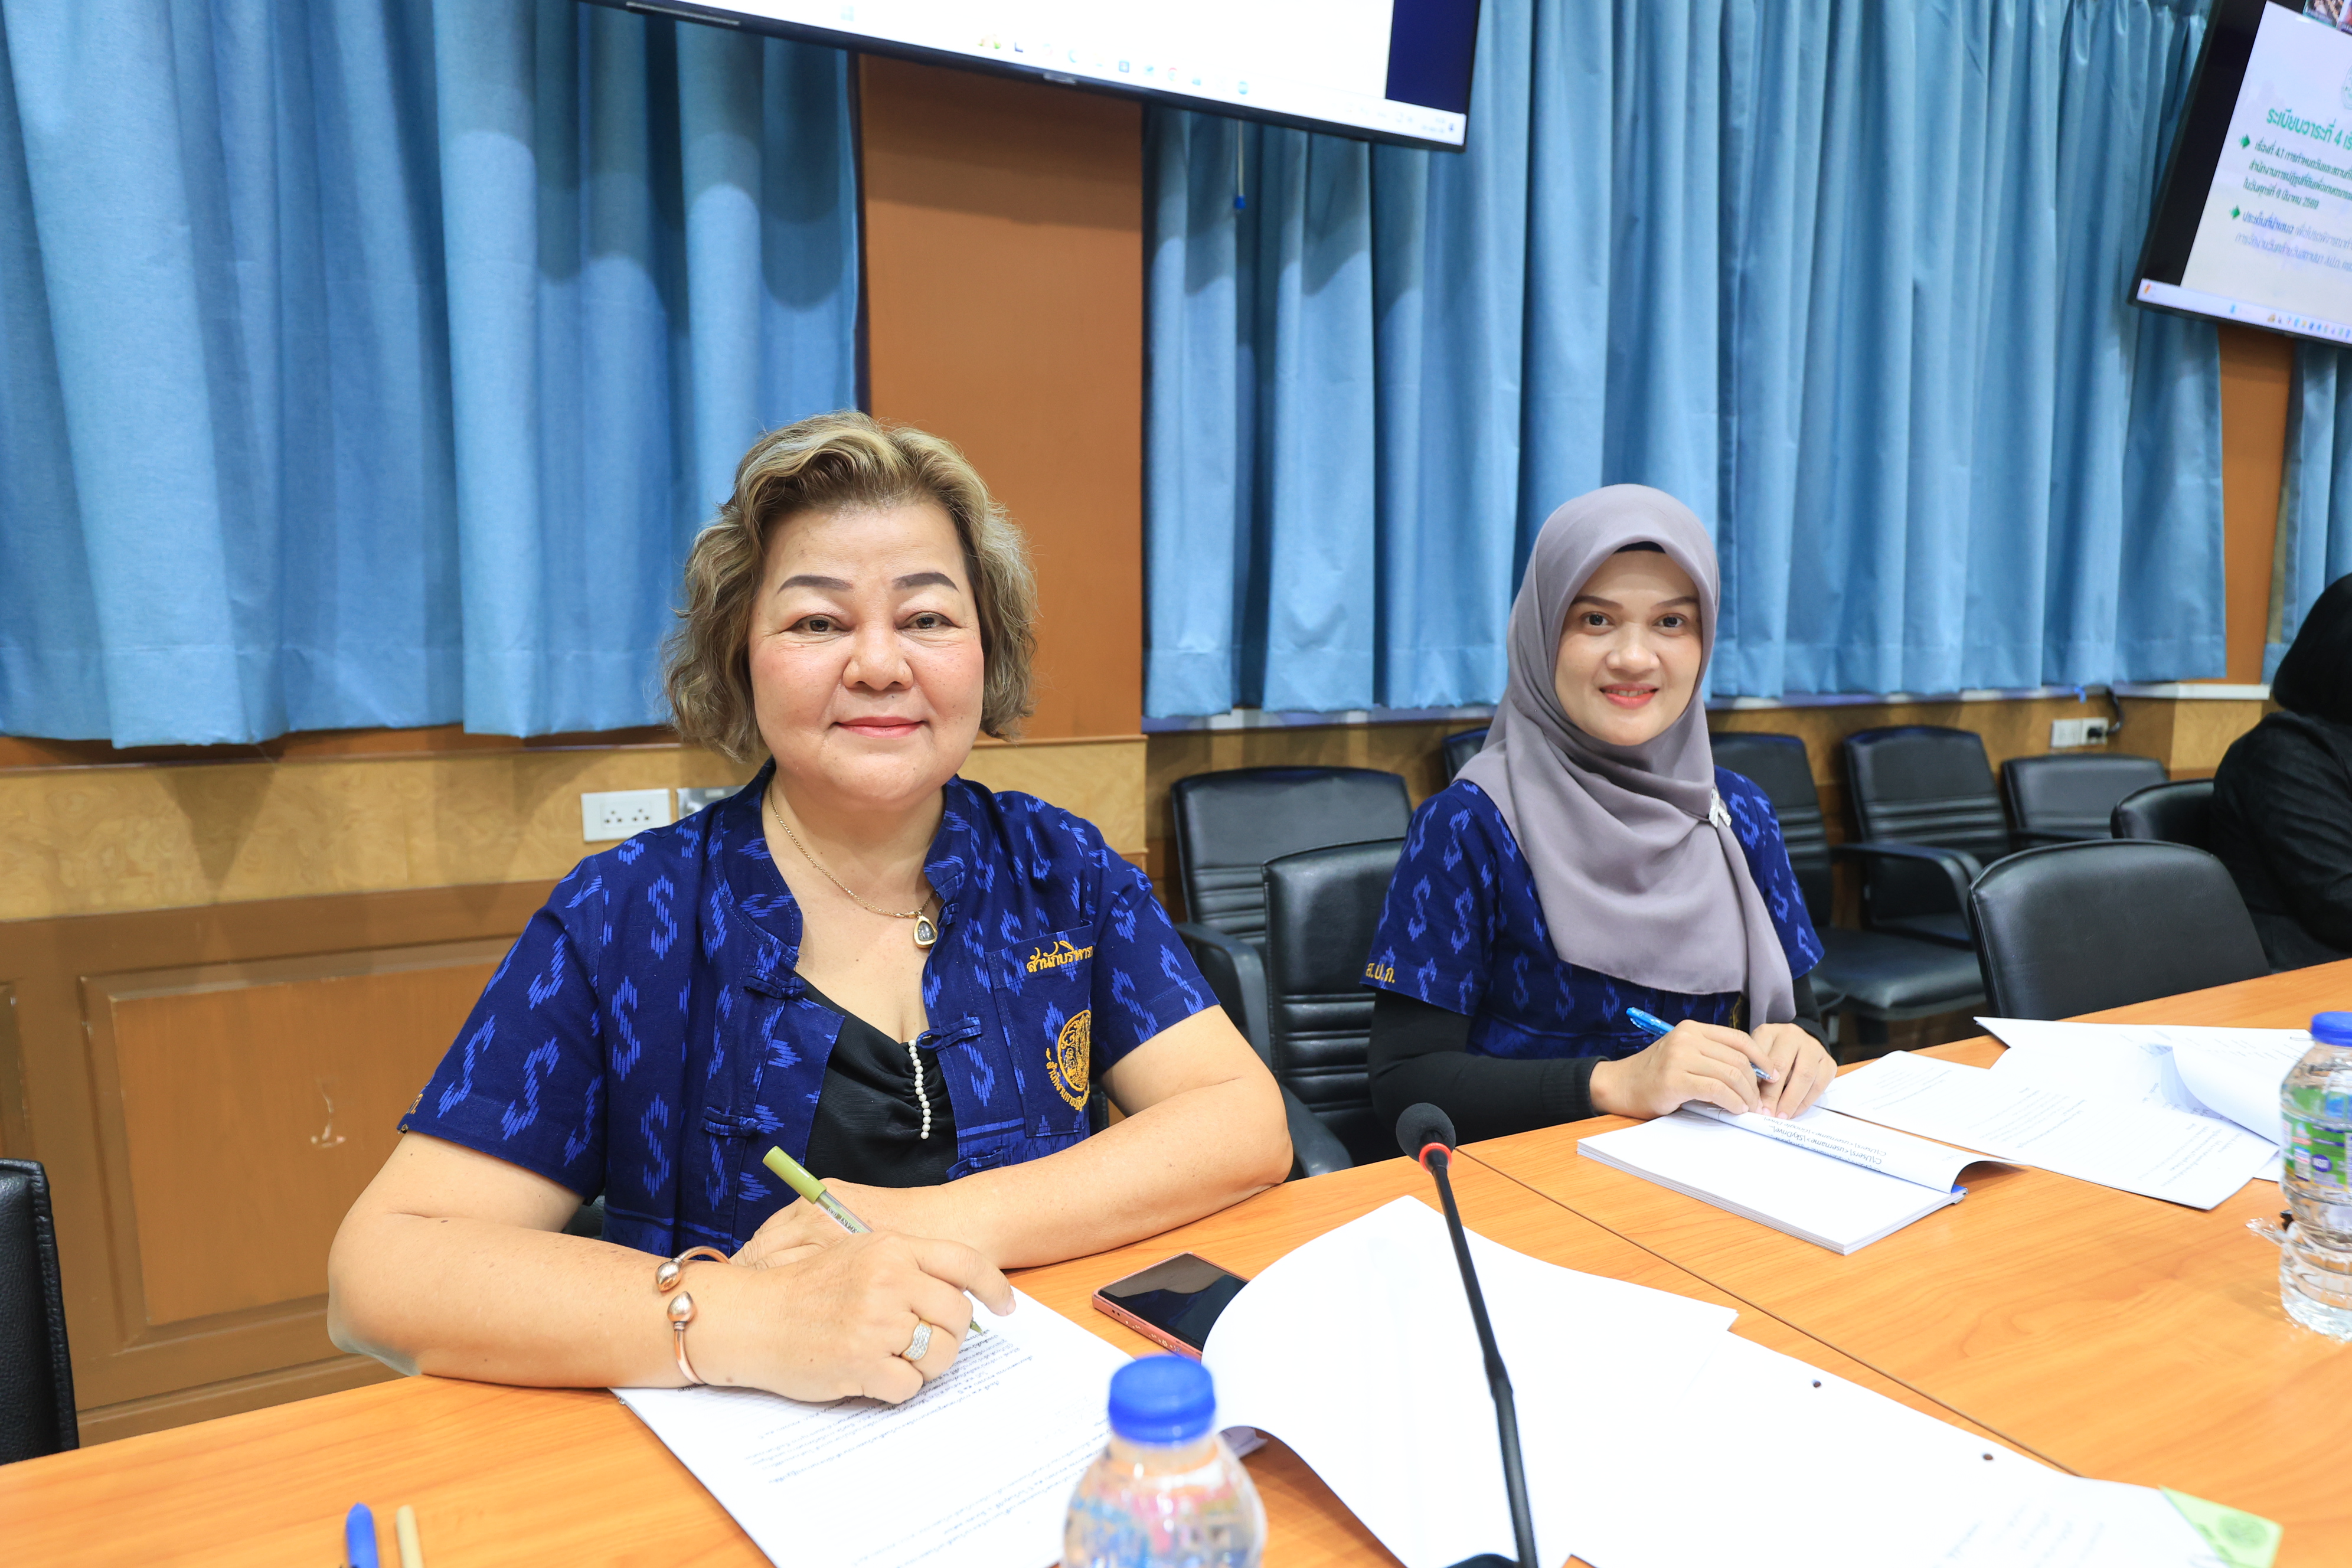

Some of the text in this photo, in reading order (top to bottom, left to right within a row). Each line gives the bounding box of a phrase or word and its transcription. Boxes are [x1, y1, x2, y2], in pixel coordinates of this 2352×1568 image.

[2266, 108, 2337, 143] ระเบียบวาระที่
[2334, 129, 2343, 146] 4
[1366, 963, 1396, 984] ส.ป.ก.
[838, 1217, 860, 1234] EGANT
